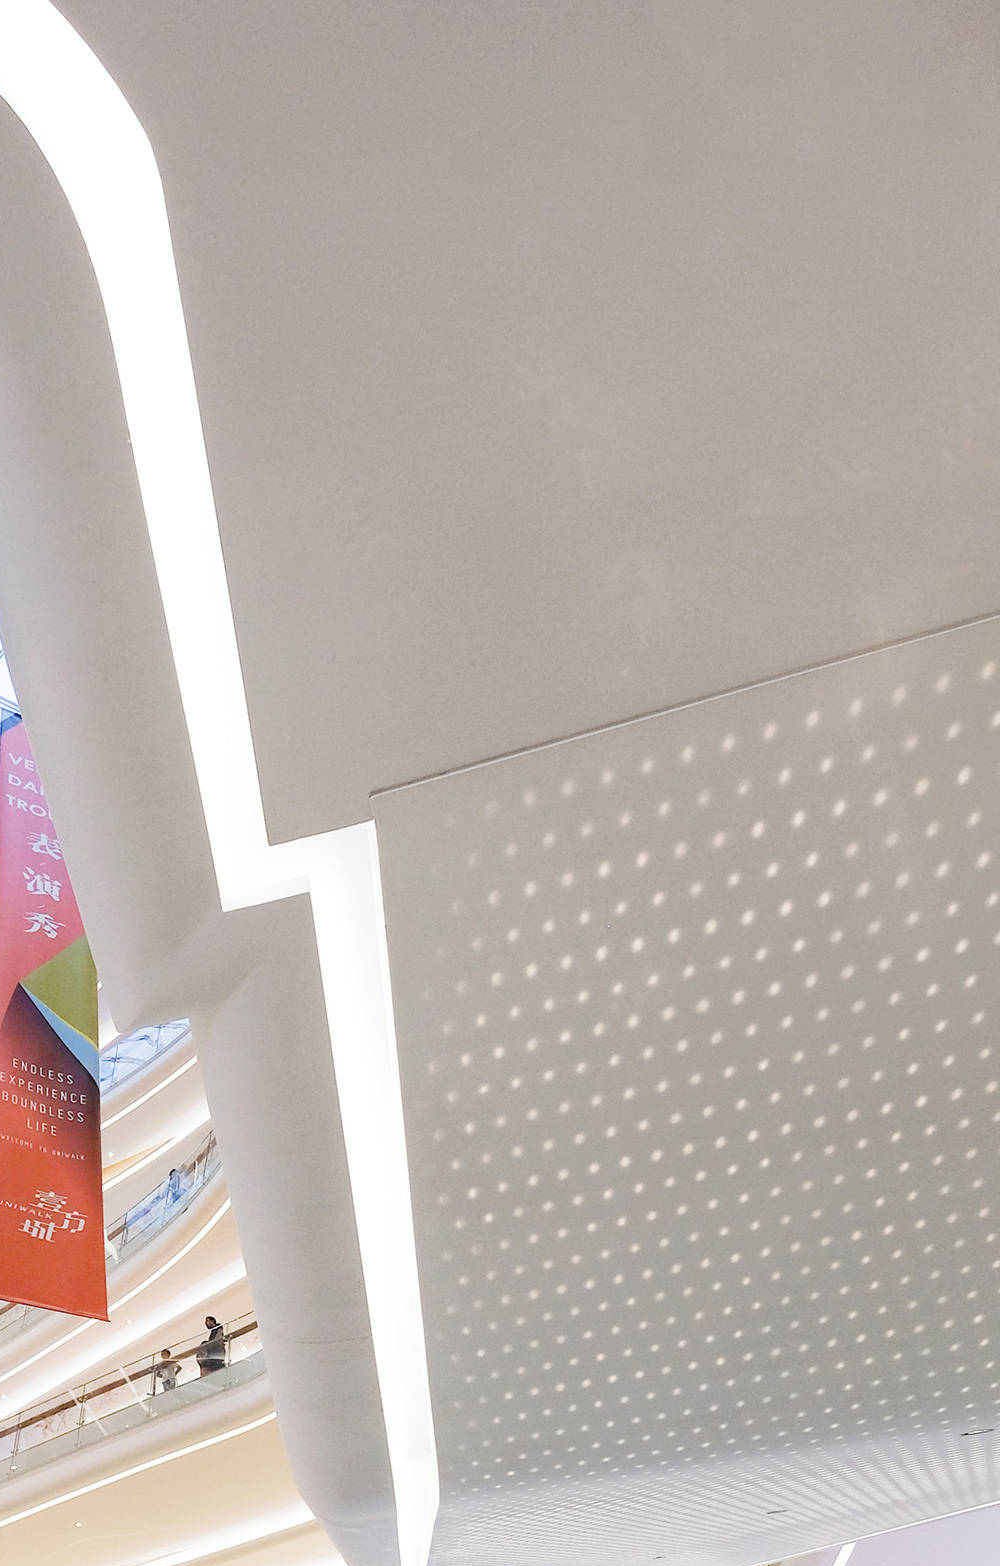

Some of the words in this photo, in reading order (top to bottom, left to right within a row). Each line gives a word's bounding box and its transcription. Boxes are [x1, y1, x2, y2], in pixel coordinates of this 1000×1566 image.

[12, 1057, 73, 1085] ENDLESS
[0, 1071, 87, 1105] EXPERIENCE
[1, 1090, 85, 1123] BOUNDLESS
[26, 1117, 57, 1137] LIFE
[0, 1133, 33, 1149] WELCOME
[38, 1145, 48, 1153] TO
[51, 1150, 86, 1161] UNIWALK
